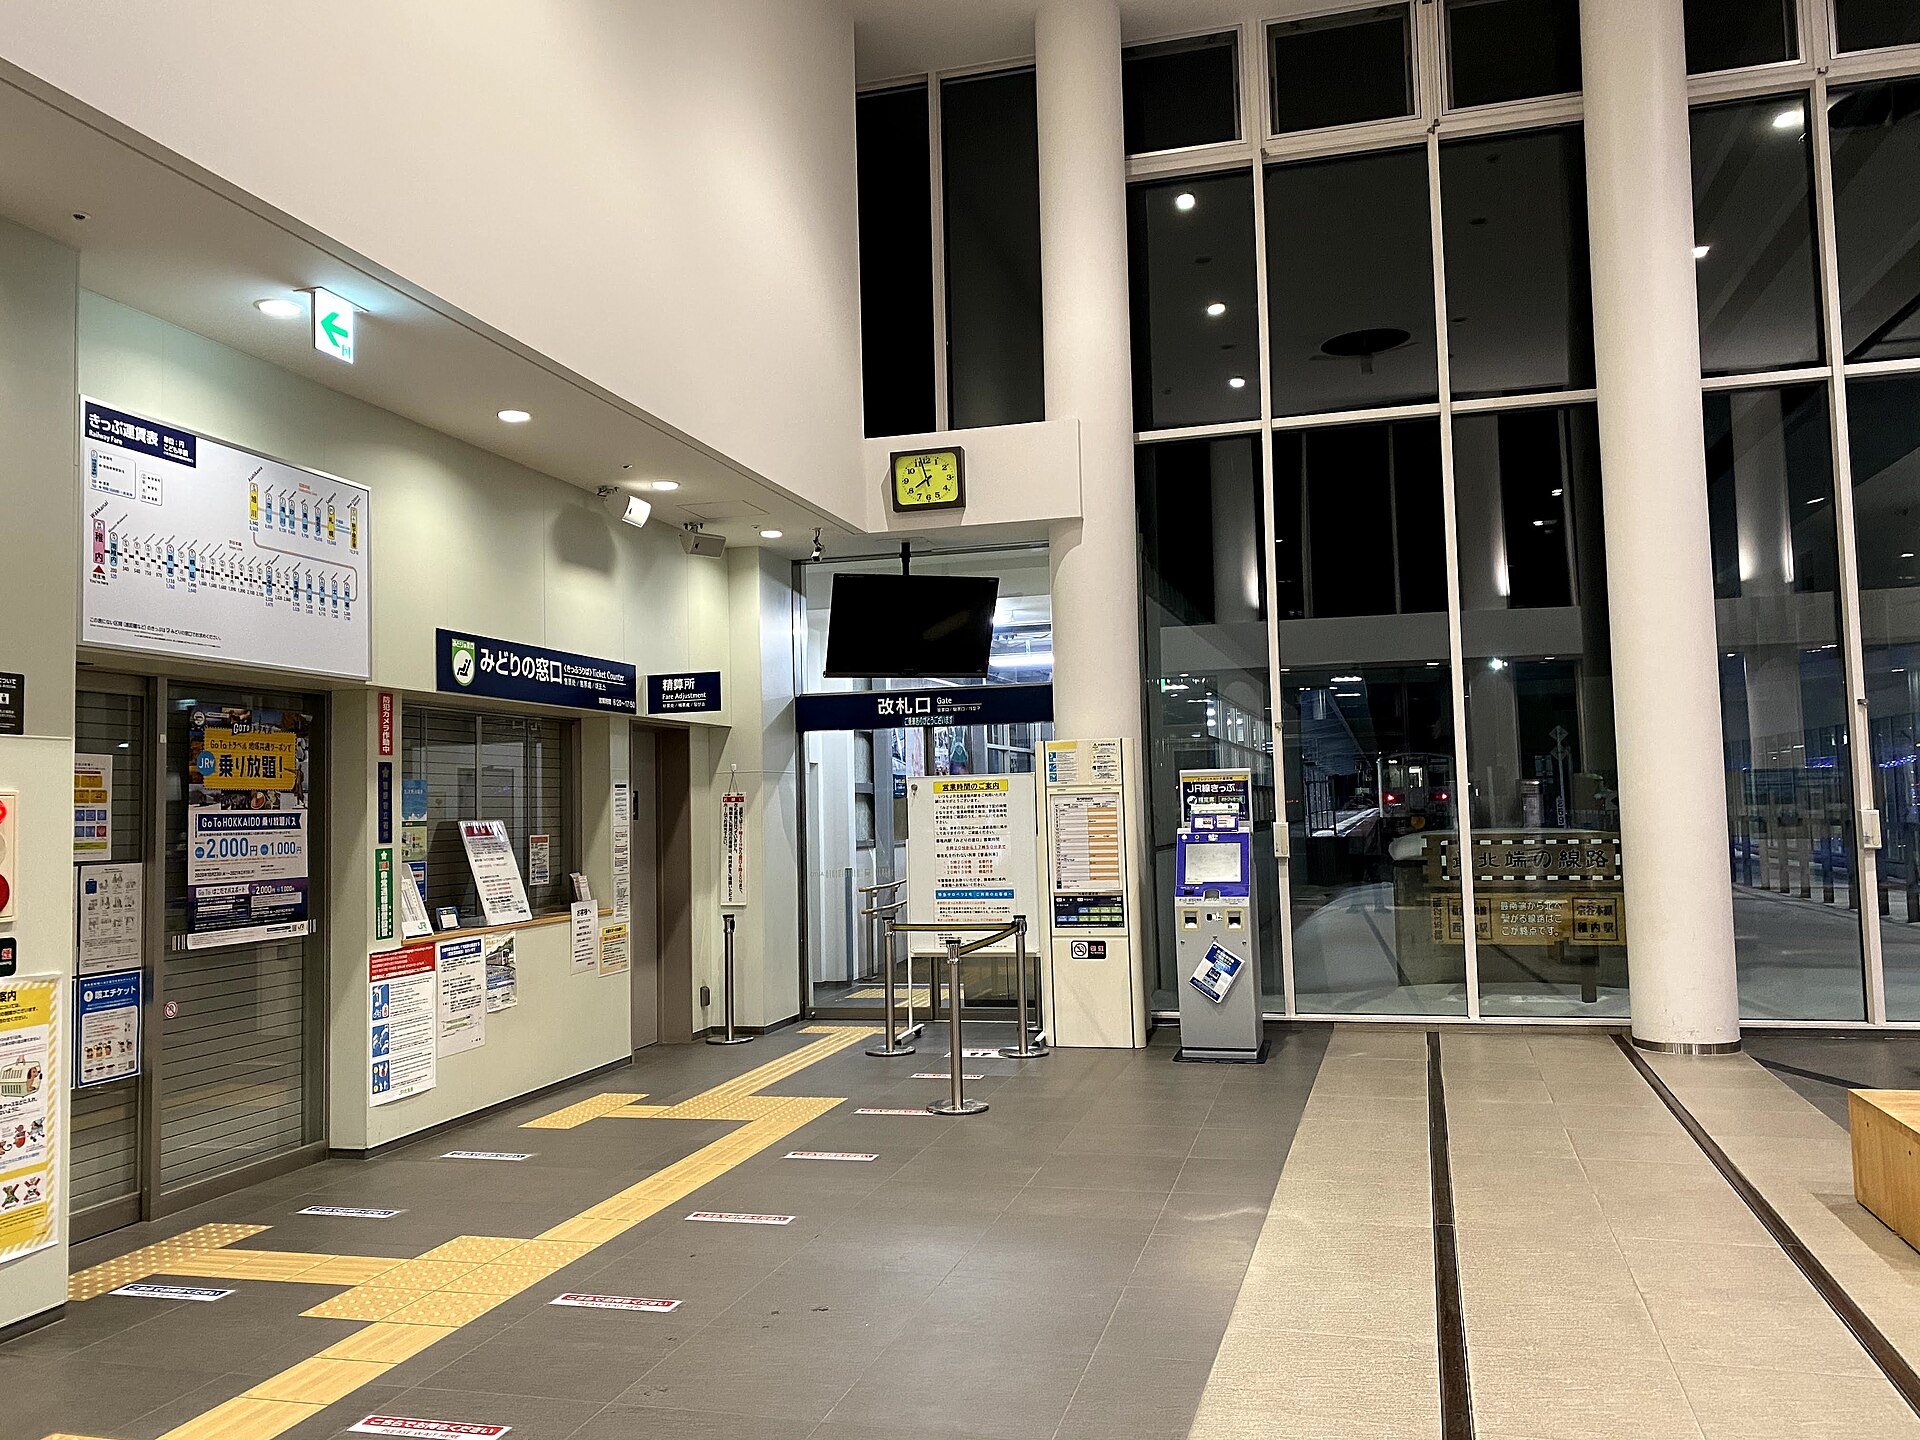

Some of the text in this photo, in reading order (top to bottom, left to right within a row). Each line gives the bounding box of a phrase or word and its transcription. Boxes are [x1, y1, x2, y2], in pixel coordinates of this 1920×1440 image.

[89, 413, 158, 446] きっぷ運賃表
[89, 429, 123, 445] Railway Fare
[480, 648, 563, 685] みどりの窓口
[592, 668, 606, 679] Ticket
[607, 671, 625, 682] Counter
[662, 677, 696, 691] 精算所
[675, 691, 706, 701] Adjustment
[877, 697, 931, 715] 改札口
[382, 695, 390, 753] 防犯カメラ作動中
[942, 782, 1000, 792] 営業時間のご案内
[1186, 783, 1236, 793] JR線きっぷ
[222, 816, 261, 827] HOKKAIDO
[1500, 901, 1562, 911] 最南端から北へ
[1576, 904, 1613, 917] 宗谷本線
[417, 921, 427, 930] JR
[1501, 926, 1560, 937] こが終点です。
[1577, 922, 1614, 933] 稚内駅
[565, 1295, 671, 1307] こちらでお待ちください
[369, 1418, 495, 1435] こちらでお待ちください
